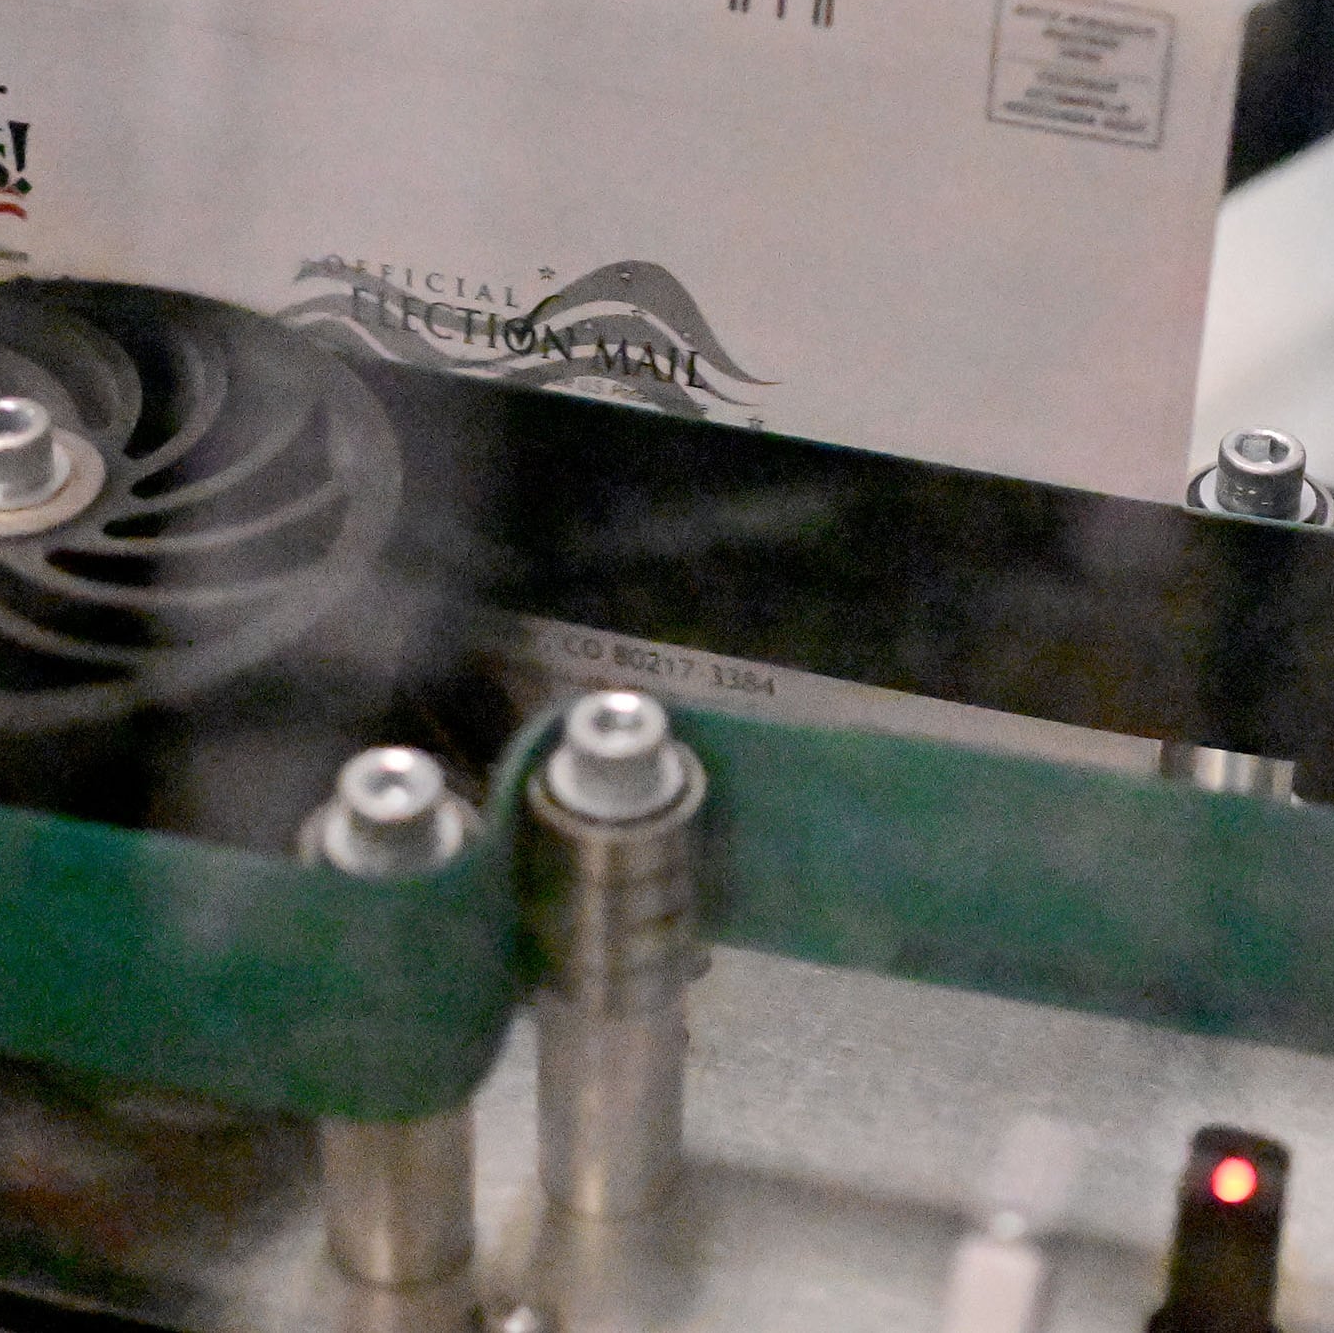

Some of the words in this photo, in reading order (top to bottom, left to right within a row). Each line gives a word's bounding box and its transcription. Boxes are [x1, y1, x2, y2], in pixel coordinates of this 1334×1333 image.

[322, 253, 520, 309] OFFICIAL
[352, 286, 576, 362] ELECTION
[591, 333, 708, 390] MAIL
[563, 633, 604, 662] CO
